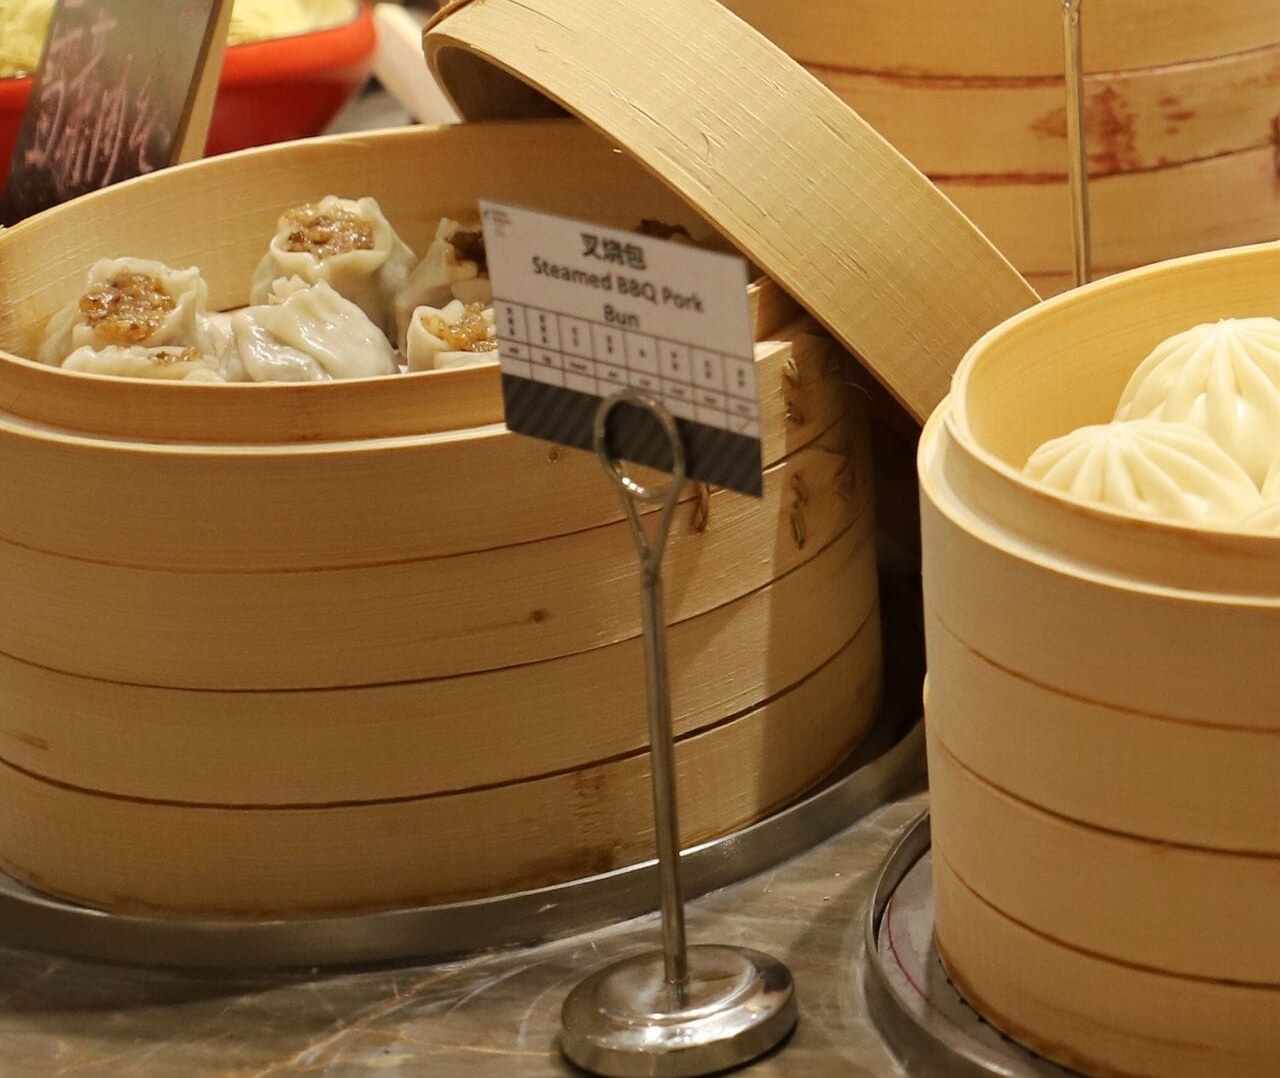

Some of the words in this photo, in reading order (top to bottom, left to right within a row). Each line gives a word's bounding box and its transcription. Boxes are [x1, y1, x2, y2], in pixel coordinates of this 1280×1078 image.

[580, 232, 647, 270] 叉烧包
[531, 255, 613, 292] Steamed
[617, 276, 659, 305] BBQ
[662, 287, 704, 313] Pork
[603, 304, 640, 328] Bun
